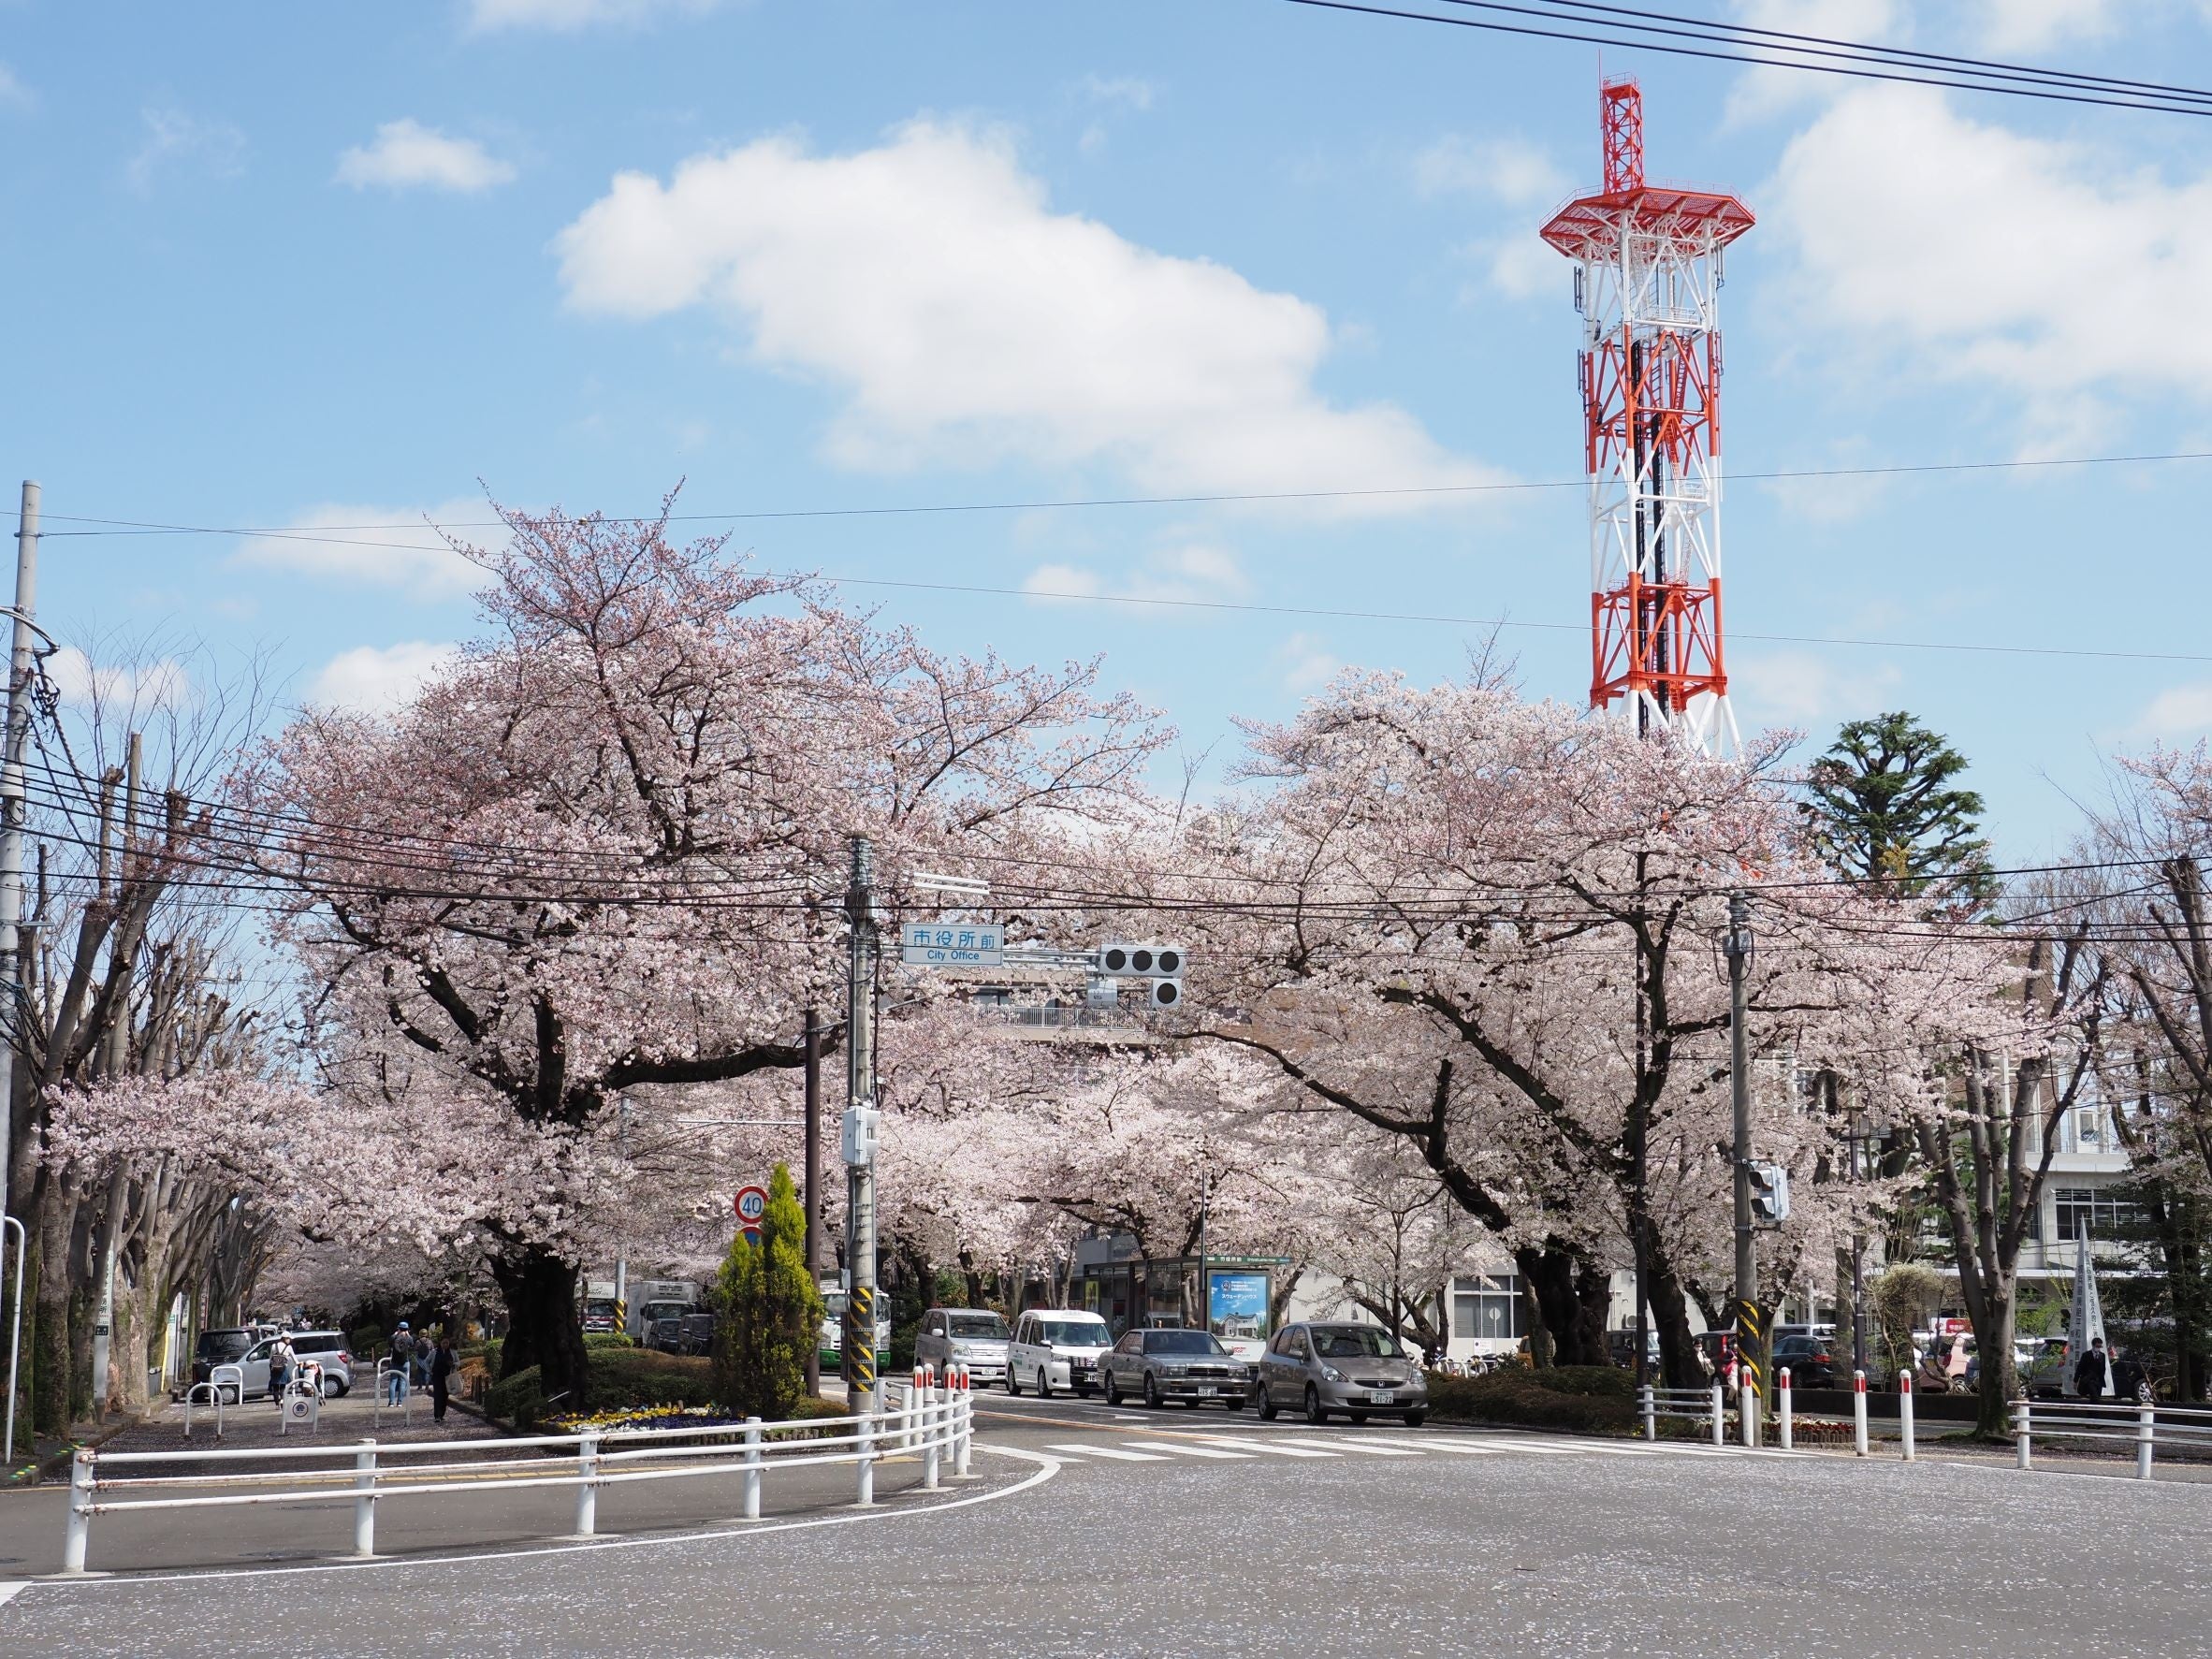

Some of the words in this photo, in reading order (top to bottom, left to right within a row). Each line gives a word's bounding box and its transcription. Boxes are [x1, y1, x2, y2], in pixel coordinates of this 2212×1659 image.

[913, 929, 995, 949] 市役所前
[927, 950, 945, 961] City
[951, 950, 980, 960] Office
[742, 1197, 762, 1214] 40
